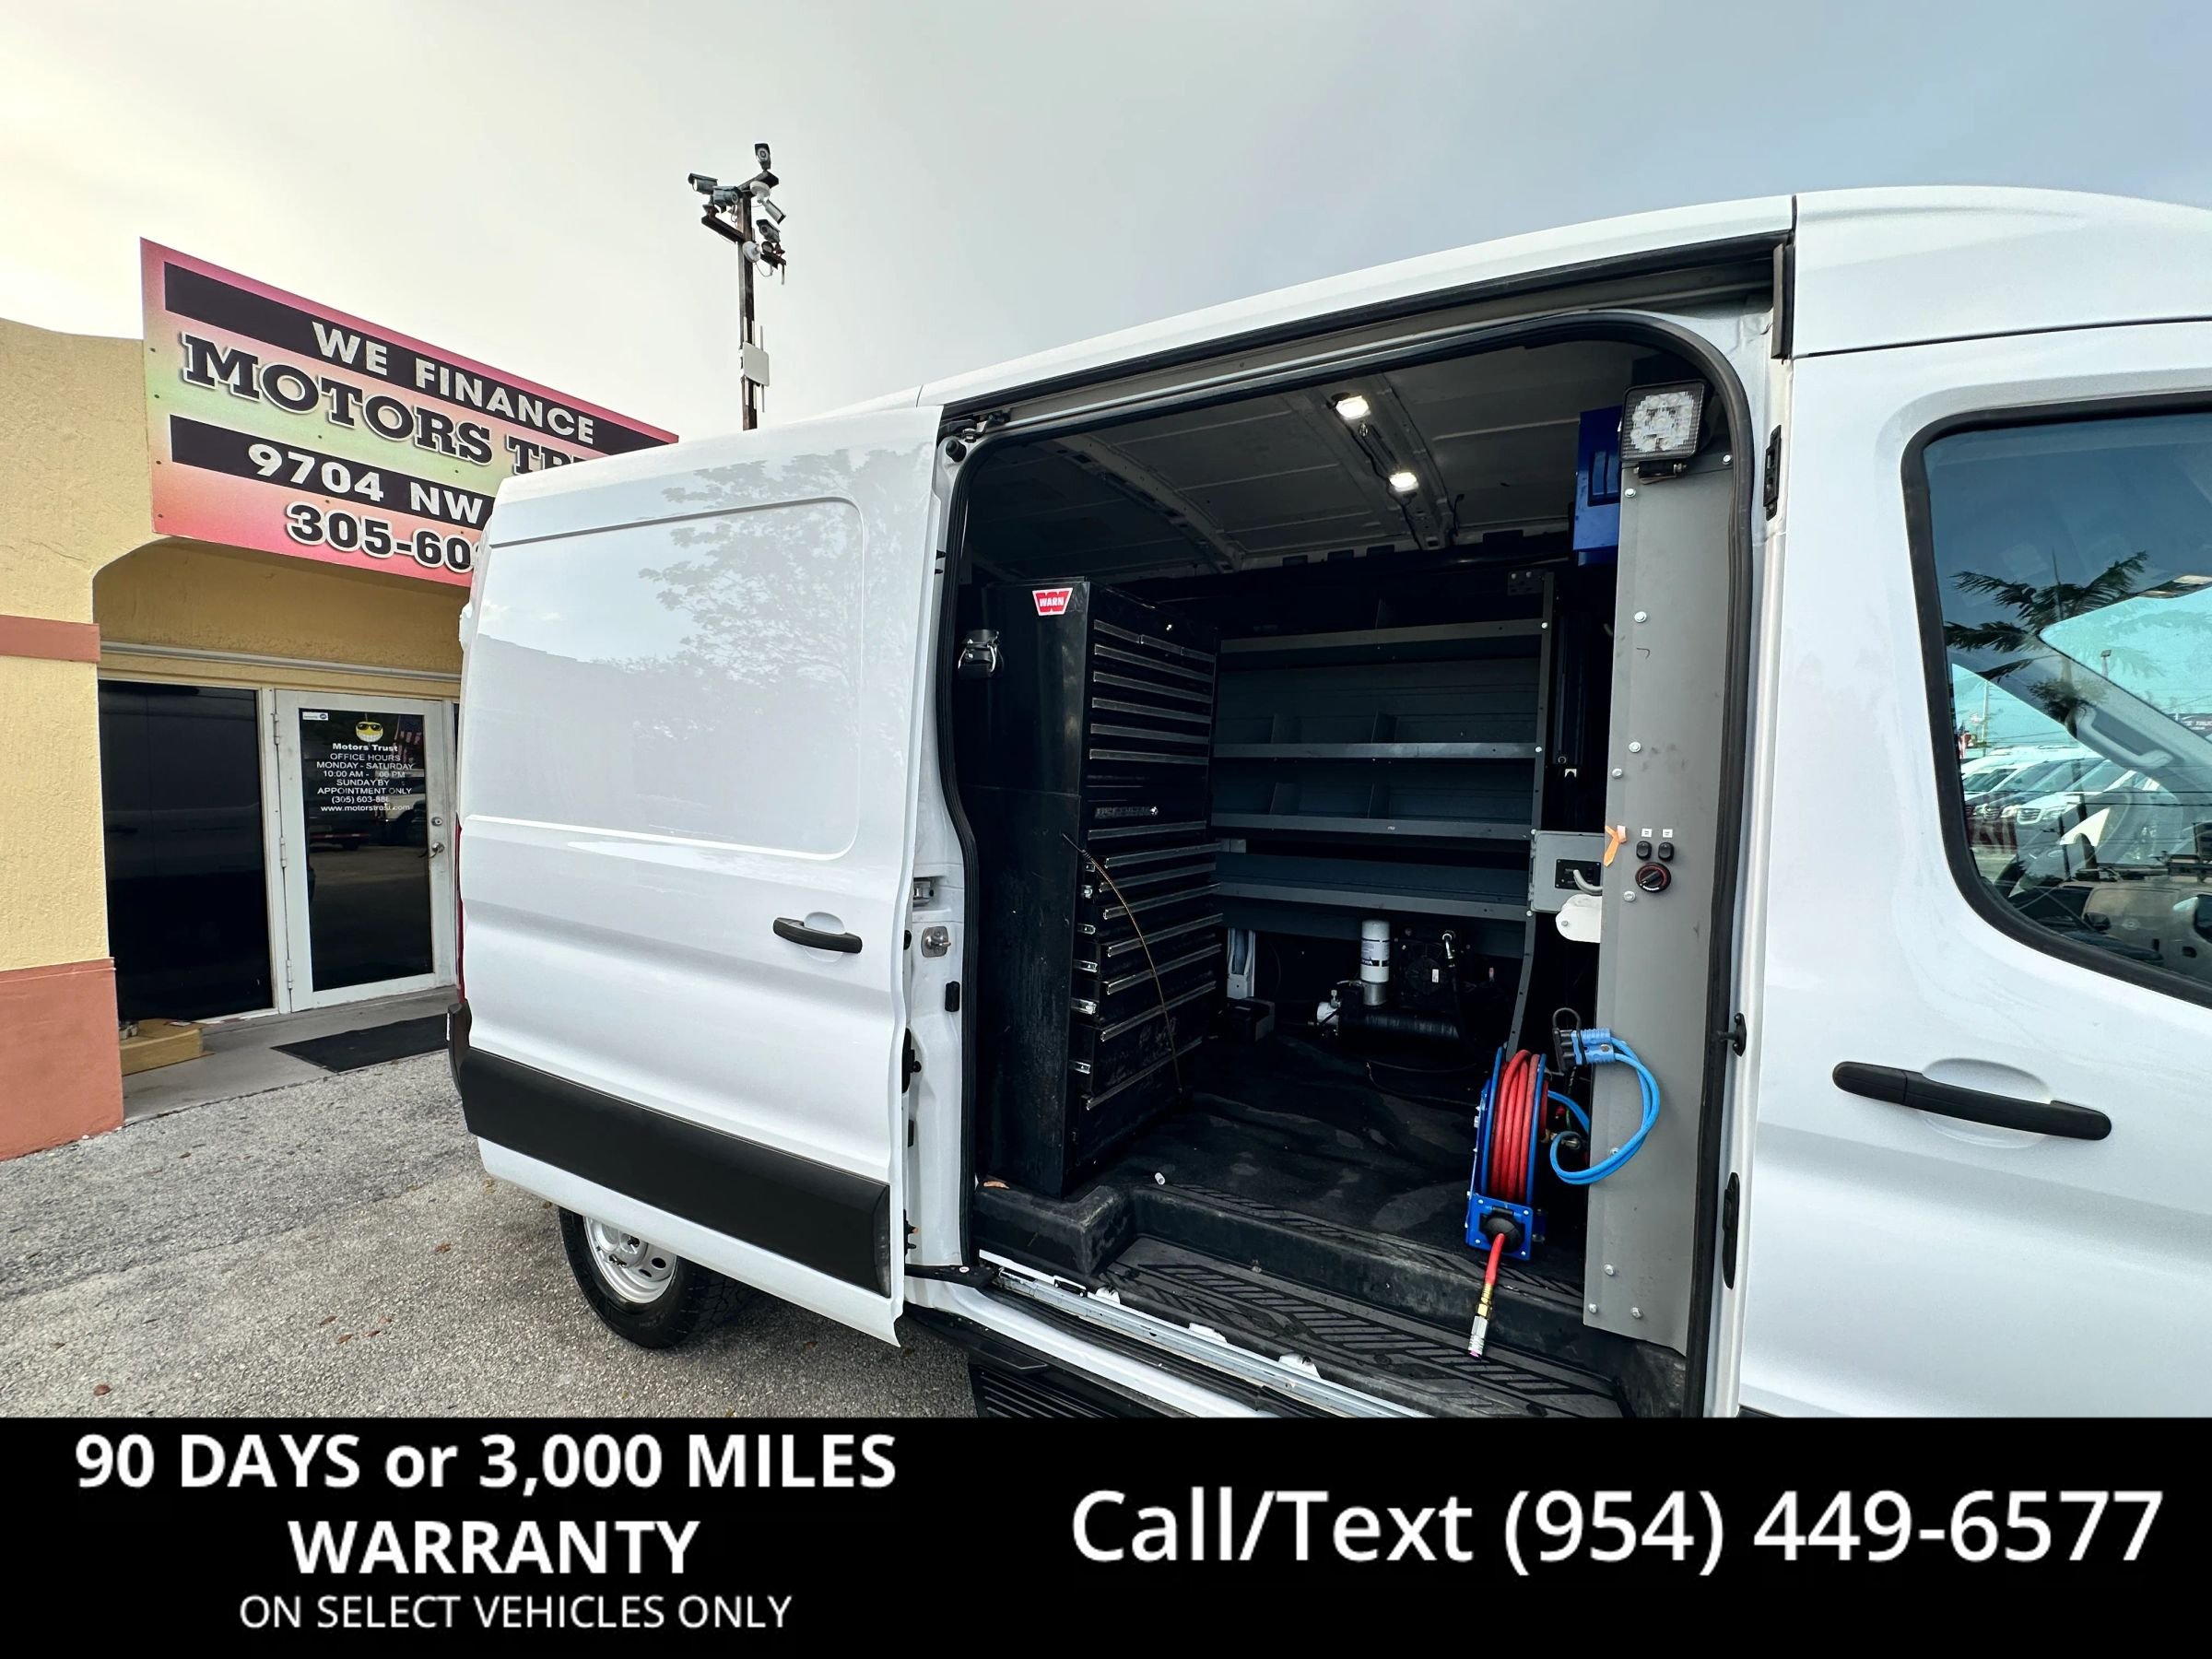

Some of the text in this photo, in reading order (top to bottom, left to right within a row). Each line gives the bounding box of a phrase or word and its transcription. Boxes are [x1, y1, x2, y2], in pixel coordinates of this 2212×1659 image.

[312, 321, 595, 445] WE FINANCE
[181, 330, 493, 466] MOTORS
[248, 443, 484, 524] 9704 NW
[286, 500, 479, 574] 305-60
[1039, 596, 1065, 607] WARN
[332, 743, 398, 752] Motors Trust
[330, 753, 401, 762] OFFICE HOURS
[365, 762, 415, 771] SATURDAY
[331, 795, 355, 805] (305)
